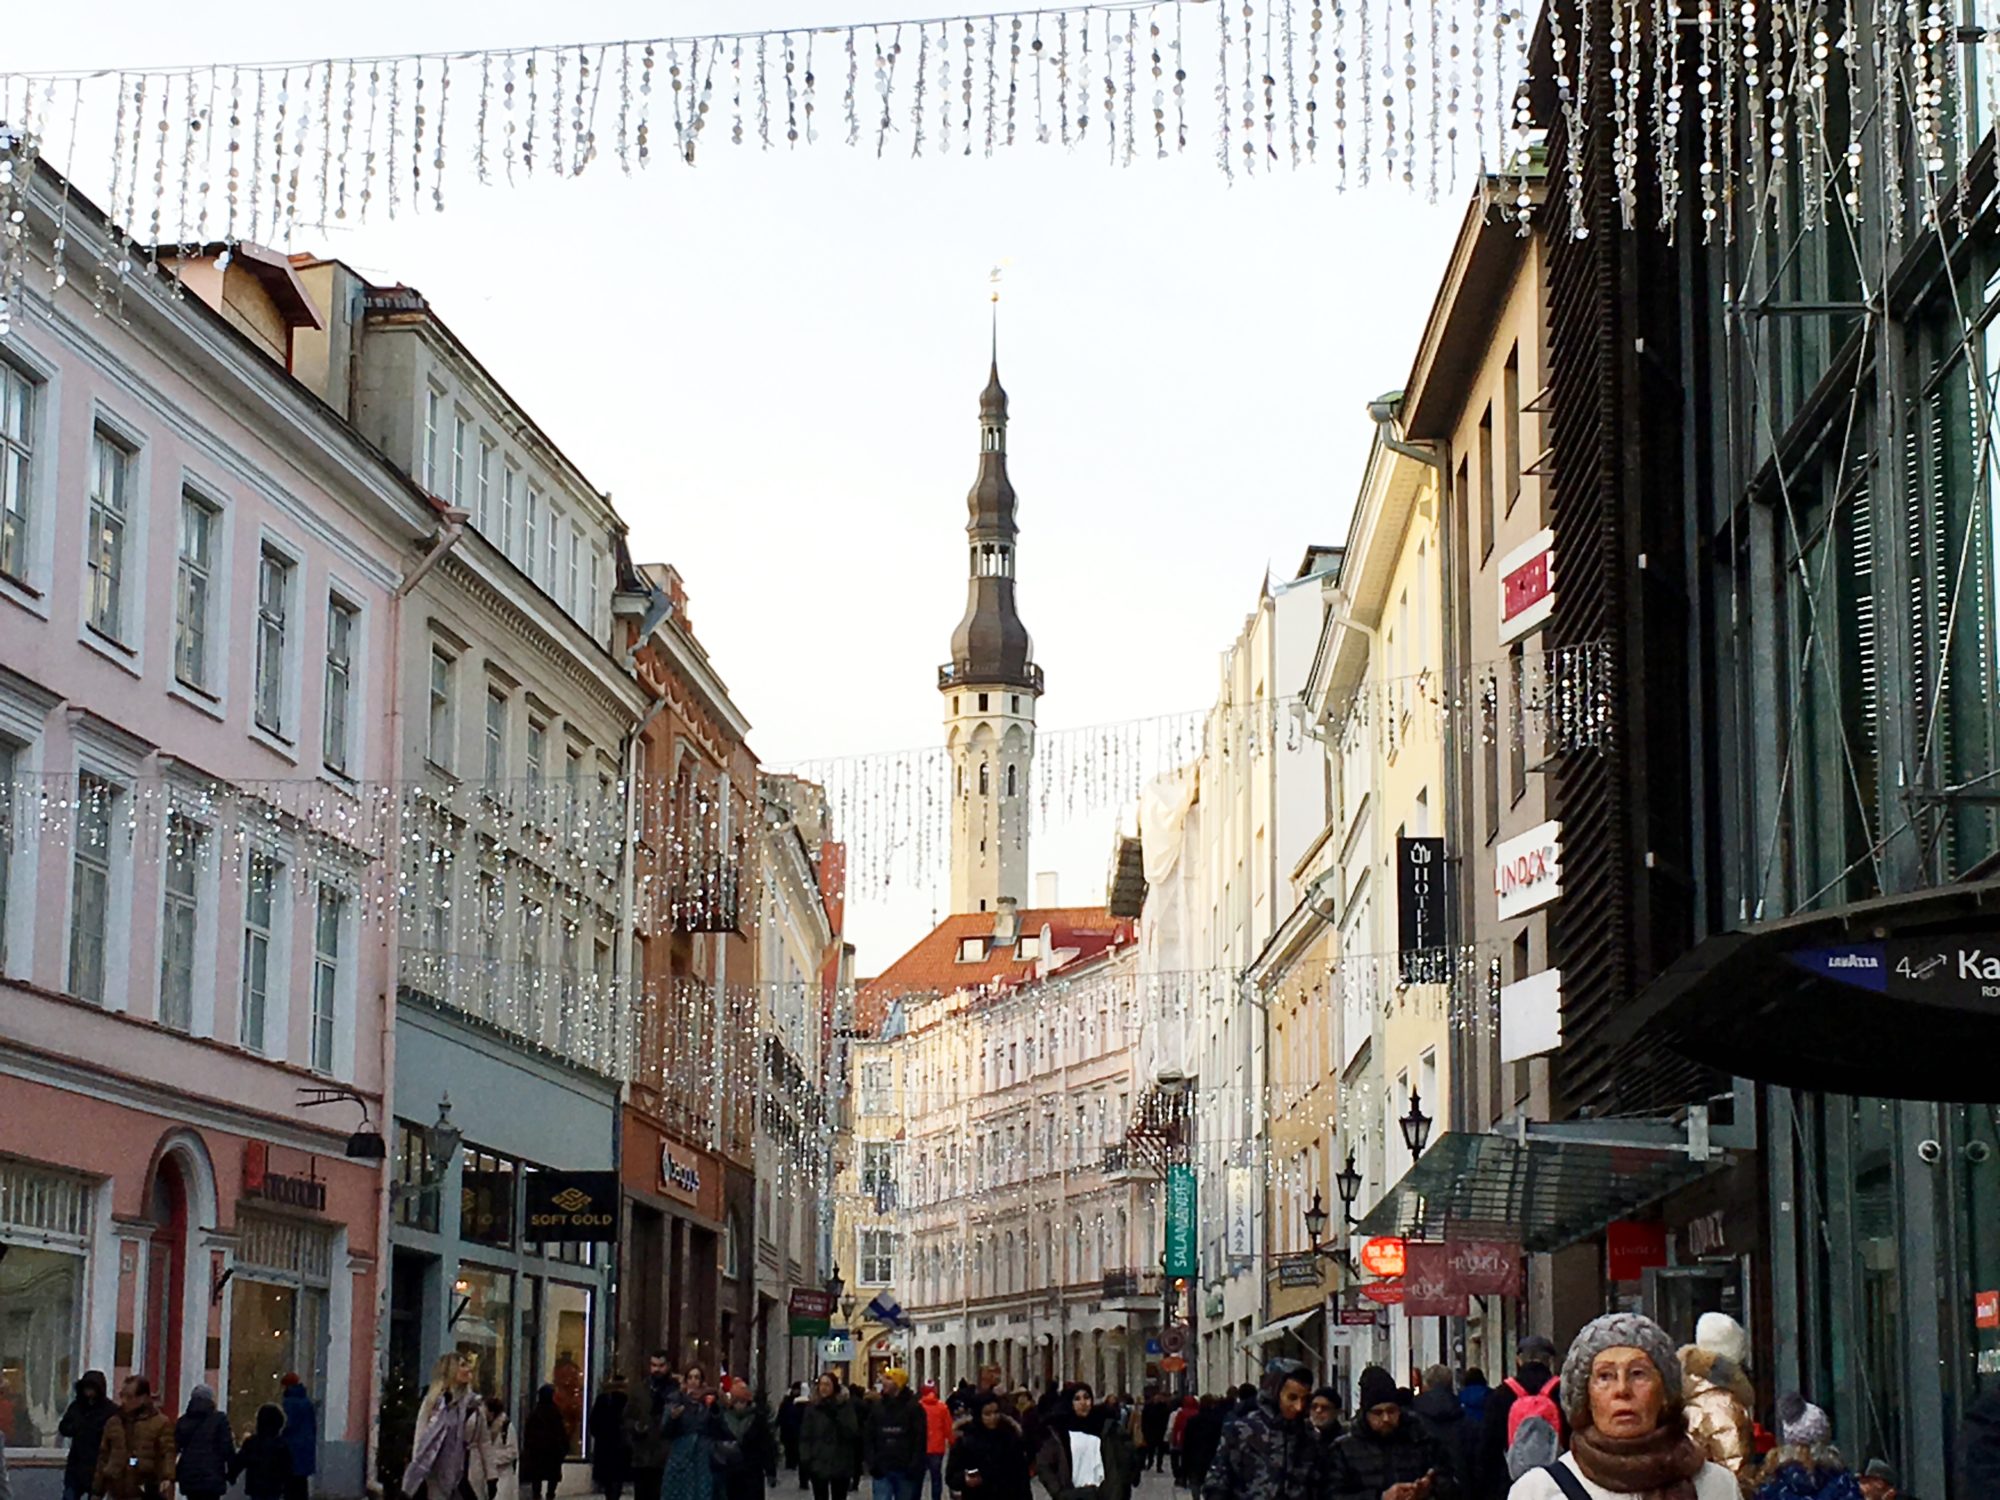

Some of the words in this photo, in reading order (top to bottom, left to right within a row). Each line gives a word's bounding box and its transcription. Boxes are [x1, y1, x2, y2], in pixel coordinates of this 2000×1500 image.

[1828, 953, 1879, 968] LAVAZZA
[1981, 985, 2000, 998] RO
[531, 1214, 567, 1226] SOFT
[571, 1214, 613, 1226] GOLD
